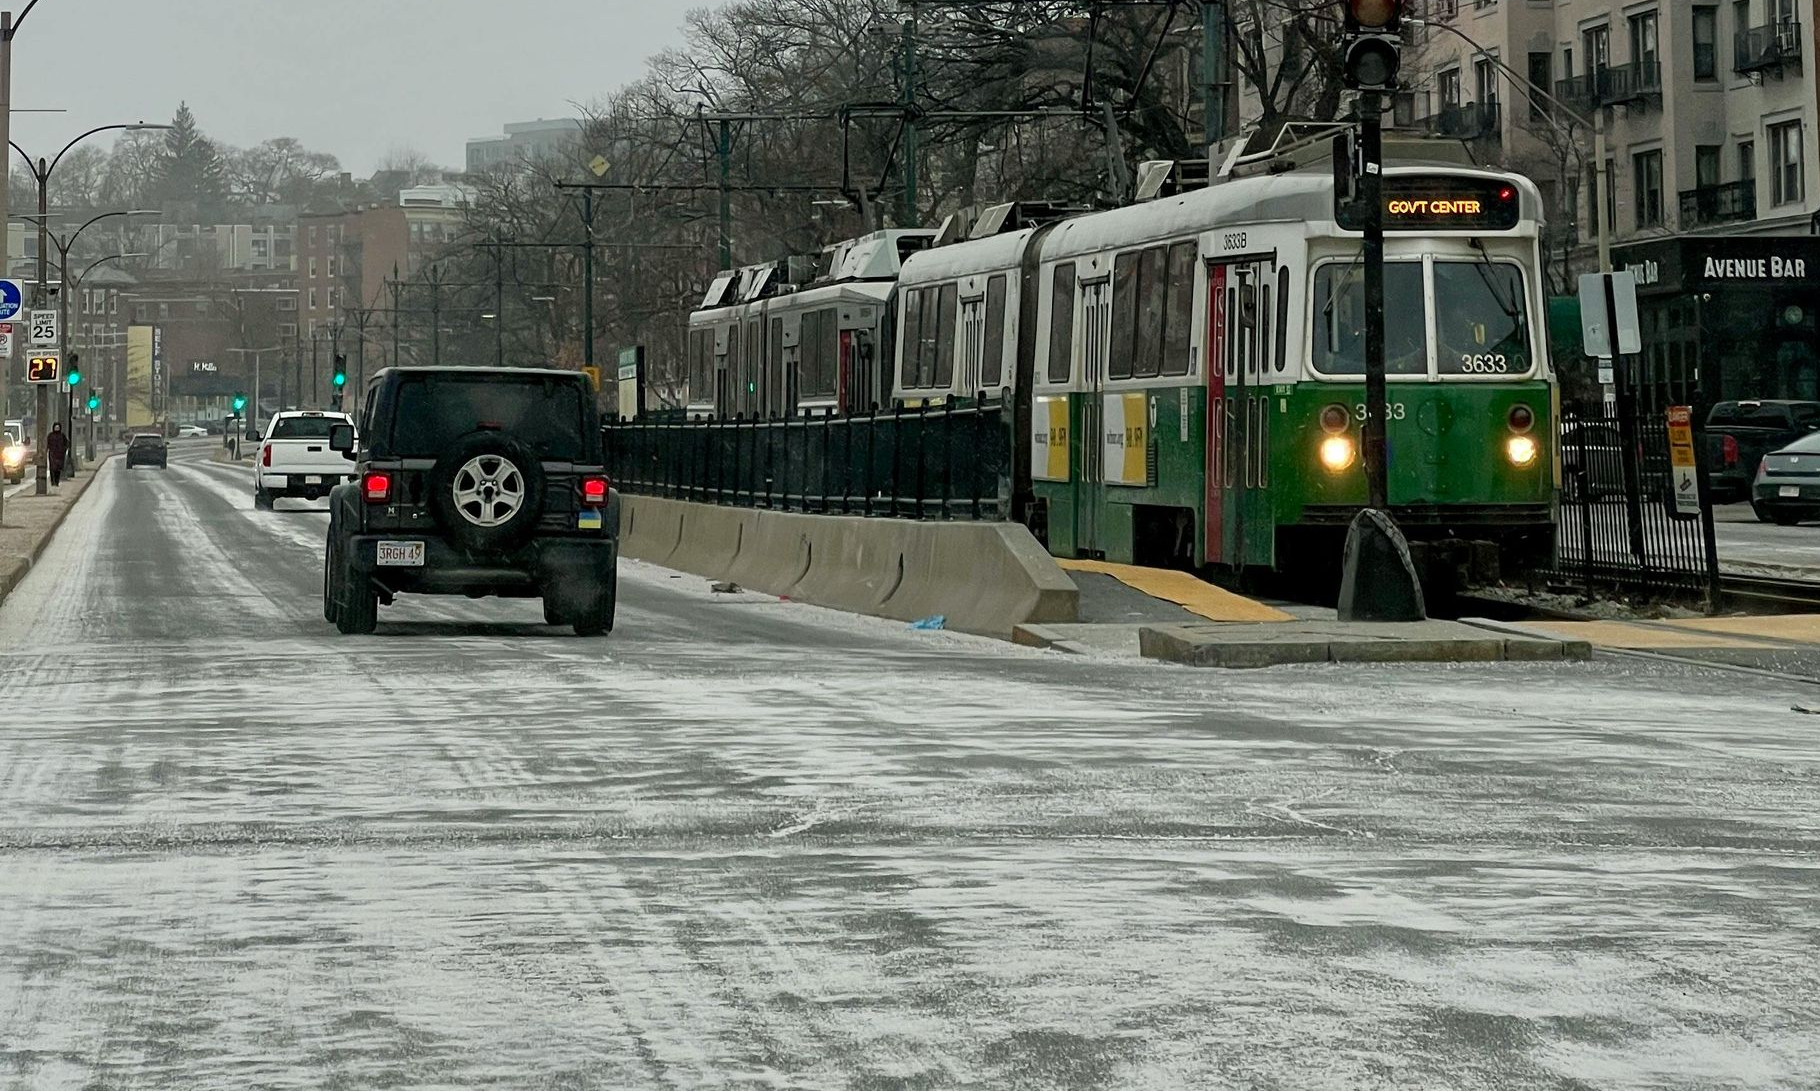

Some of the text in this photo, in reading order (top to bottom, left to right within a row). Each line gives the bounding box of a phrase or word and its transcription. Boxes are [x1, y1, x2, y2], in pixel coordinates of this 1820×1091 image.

[1430, 200, 1481, 214] CENTER
[1223, 232, 1247, 250] 3633B
[1704, 256, 1806, 278] AVENUE BAR
[33, 326, 54, 338] 25
[30, 358, 57, 380] 27
[1461, 354, 1507, 373] 3633
[1355, 403, 1405, 420] 333
[379, 547, 421, 560] 3RGH 49
